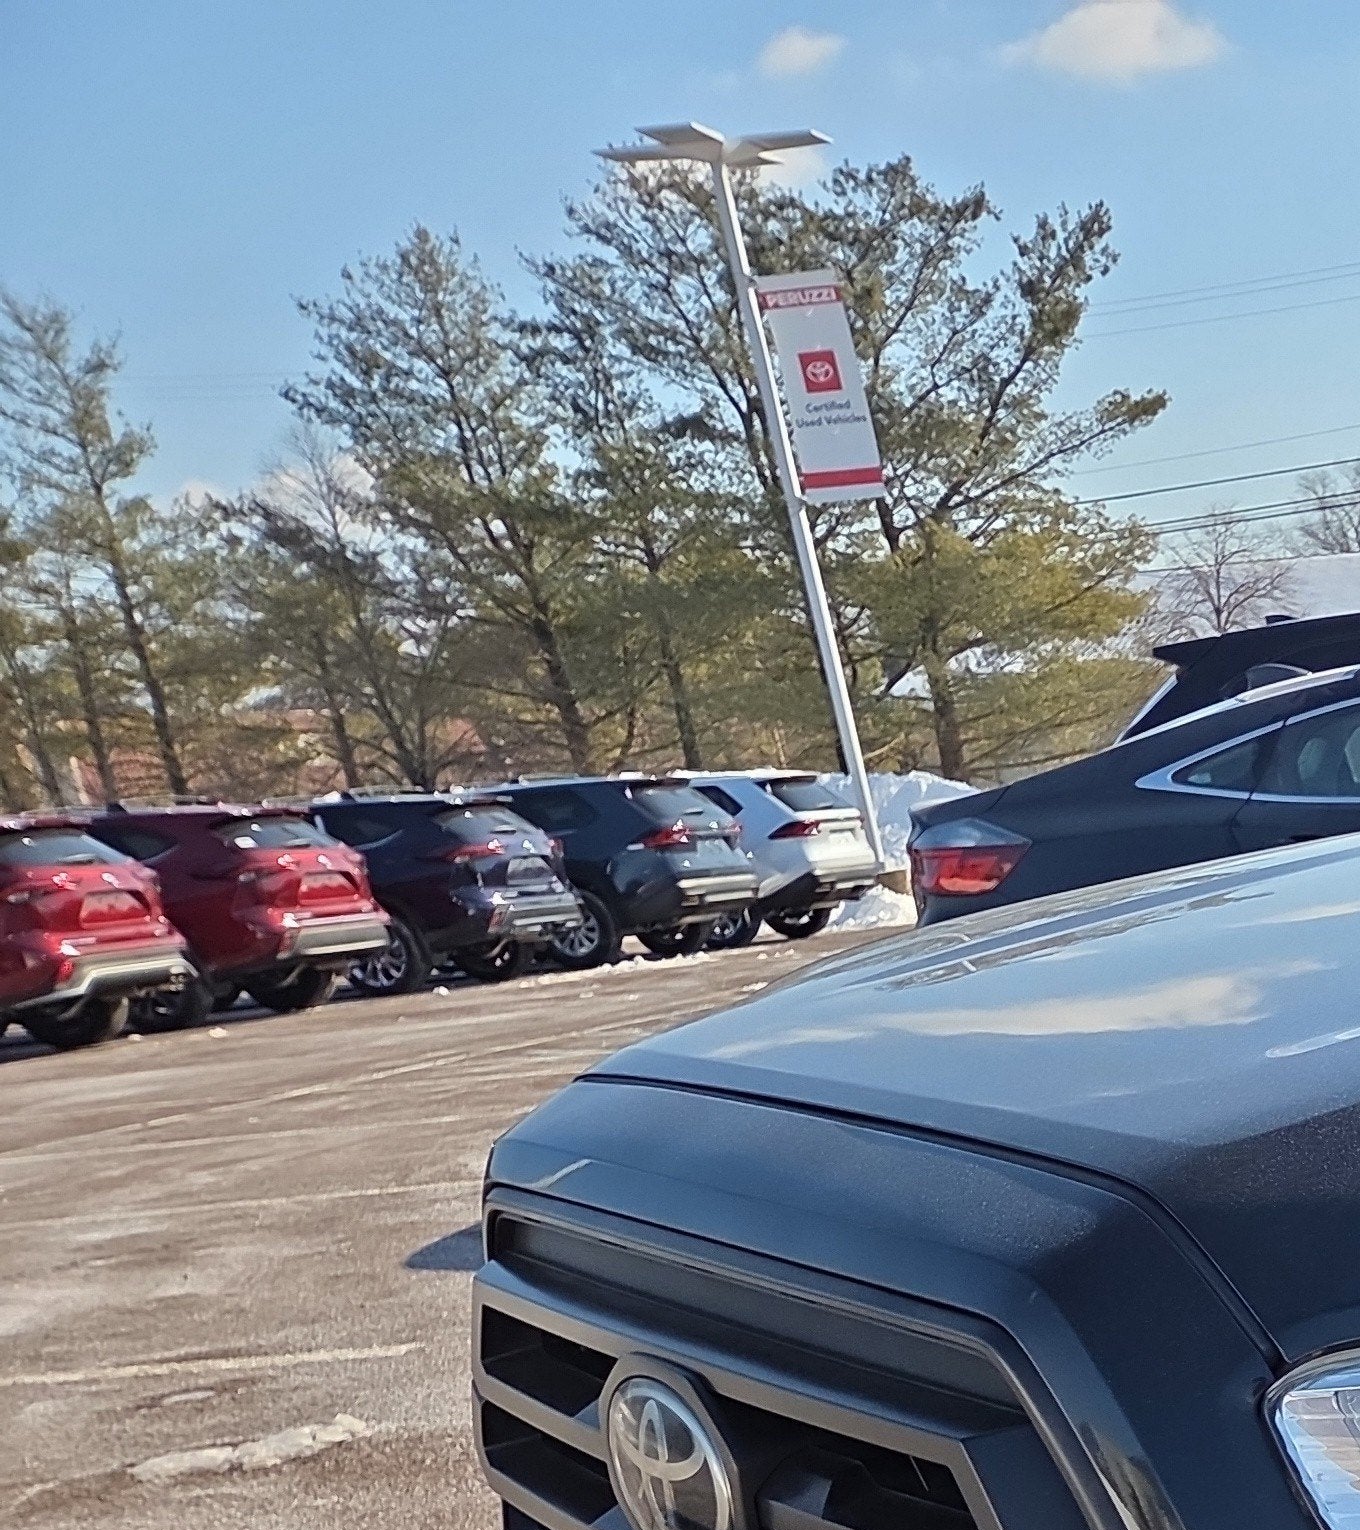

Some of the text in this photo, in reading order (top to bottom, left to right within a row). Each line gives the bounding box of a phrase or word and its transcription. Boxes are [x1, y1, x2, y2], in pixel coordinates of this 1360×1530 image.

[765, 286, 837, 308] PERUZZI
[805, 399, 851, 413] Certified
[796, 413, 867, 428] Used Vehicles
